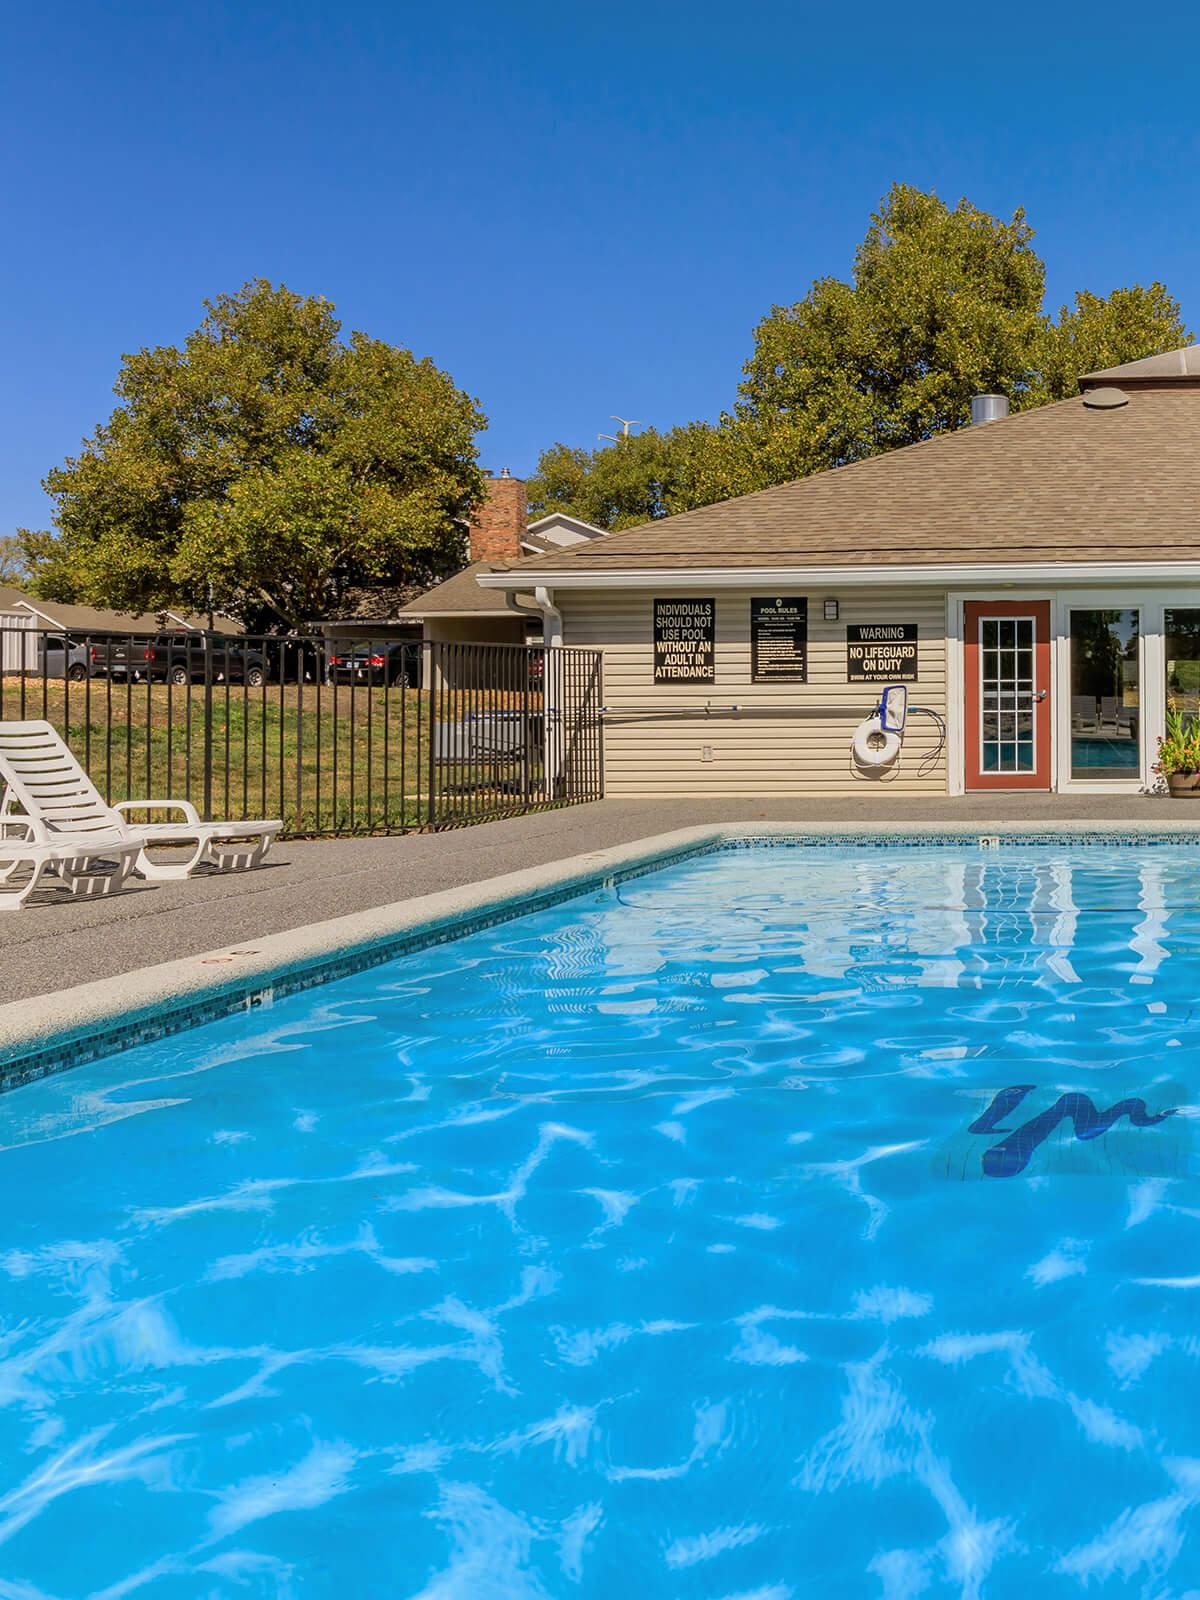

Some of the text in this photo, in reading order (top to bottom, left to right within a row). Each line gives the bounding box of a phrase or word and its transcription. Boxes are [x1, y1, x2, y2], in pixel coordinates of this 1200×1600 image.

[657, 604, 711, 616] INDIVIDUALS
[656, 617, 712, 628] SHOULD NOT
[662, 629, 706, 640] USE POOL
[860, 627, 905, 639] WARNING
[657, 641, 711, 653] WITHOUT AN
[849, 646, 915, 659] NO LIFEGUARD
[664, 653, 704, 665] ADULT IN
[863, 659, 902, 671] ON DUTY
[655, 666, 714, 678] ATTENDANCE
